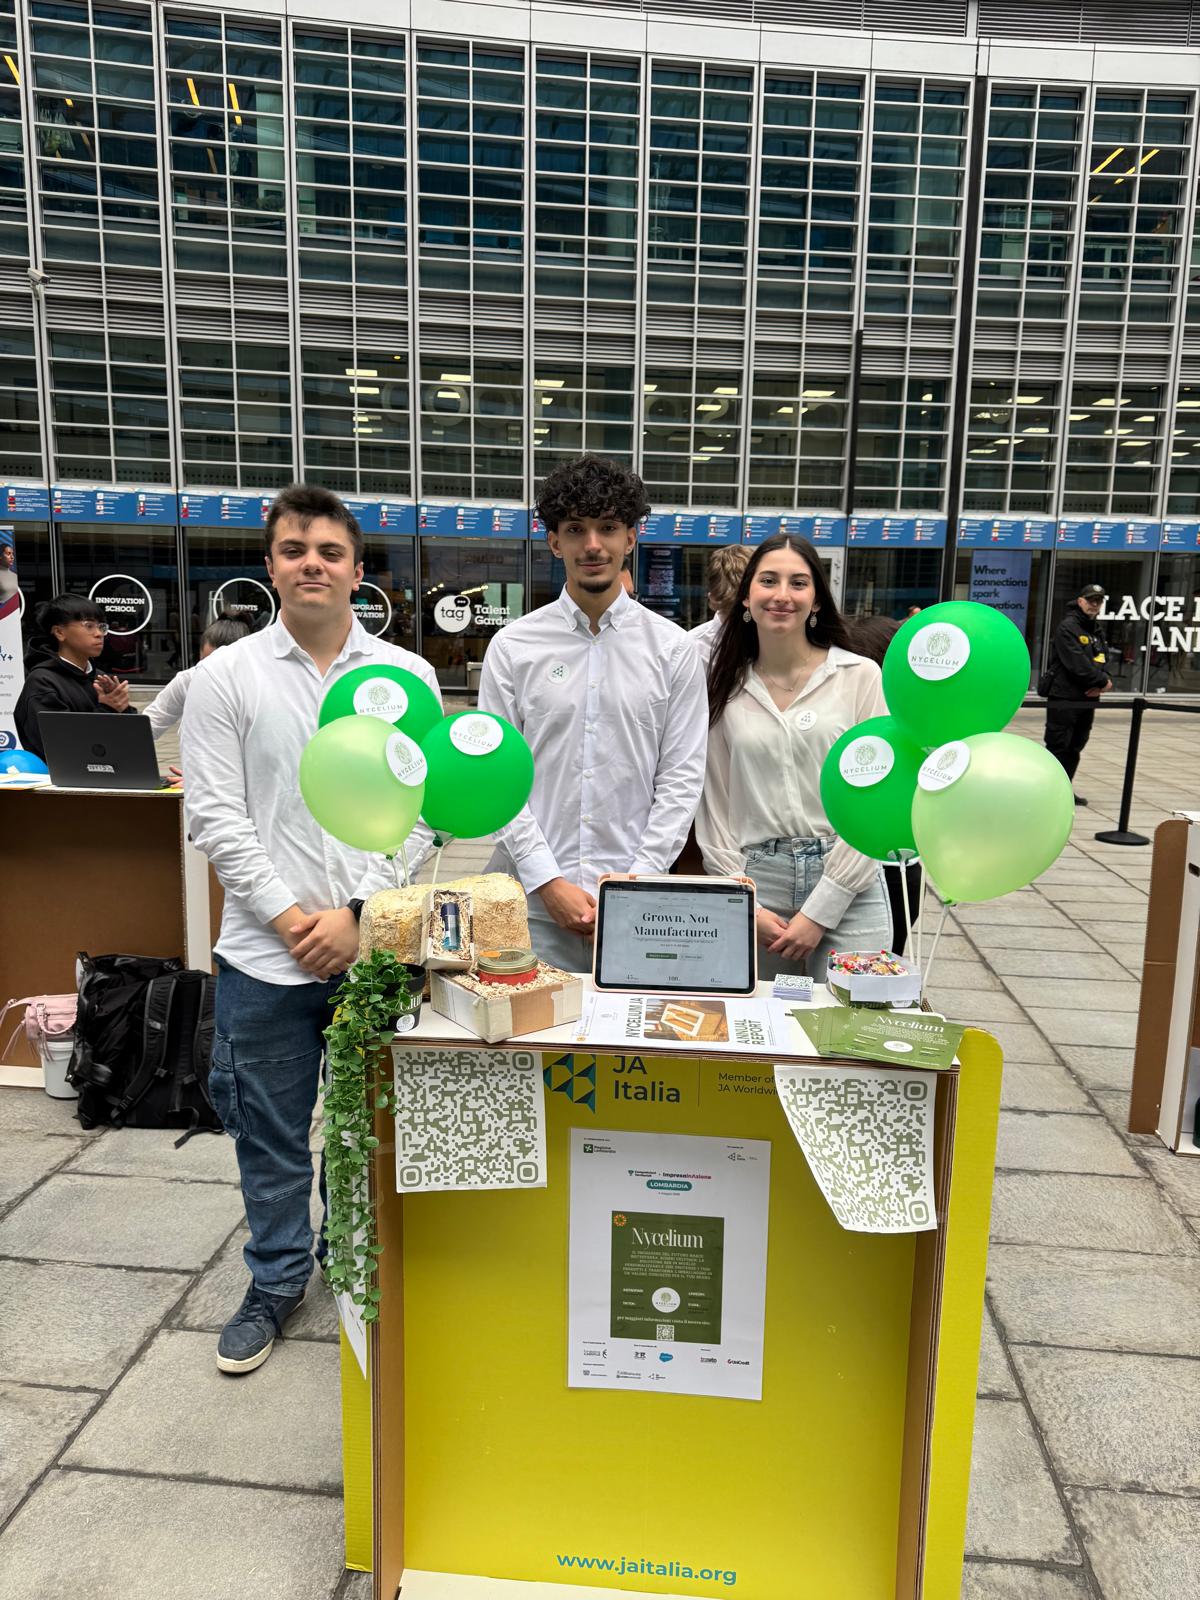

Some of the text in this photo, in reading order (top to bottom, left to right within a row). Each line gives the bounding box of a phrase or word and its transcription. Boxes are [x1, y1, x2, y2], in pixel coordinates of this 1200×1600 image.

[974, 565, 1007, 575] Where
[973, 577, 1028, 587] connections
[972, 588, 1000, 600] spark
[95, 597, 145, 605] INNOVATION
[988, 600, 1025, 610] vation.
[105, 605, 136, 613] SCHOOL
[441, 606, 466, 621] tag
[474, 604, 510, 614] Talent
[1096, 595, 1185, 621] LACE
[1140, 626, 1200, 653] AN
[911, 655, 960, 666] NYCELIUM
[360, 704, 403, 713] NYCELIUM
[453, 730, 493, 747] NYCELIUM
[397, 758, 424, 777] NYCELIUM
[843, 765, 887, 774] NYCELIUM
[922, 766, 953, 781] NYCELIUM
[642, 912, 709, 924] Grown, Not
[633, 926, 718, 938] Manufactured
[625, 1005, 643, 1038] NYCELIUM
[875, 1015, 945, 1033] Nycelium
[734, 1019, 750, 1045] ANNUAL
[748, 1020, 765, 1045] REPORT
[612, 1055, 648, 1074] JA
[718, 1072, 762, 1082] Member
[614, 1080, 680, 1102] Italia
[718, 1083, 778, 1095] JA Worldwi
[632, 1227, 703, 1250] Nycelium
[556, 1554, 737, 1586] www.jaitalia.org
